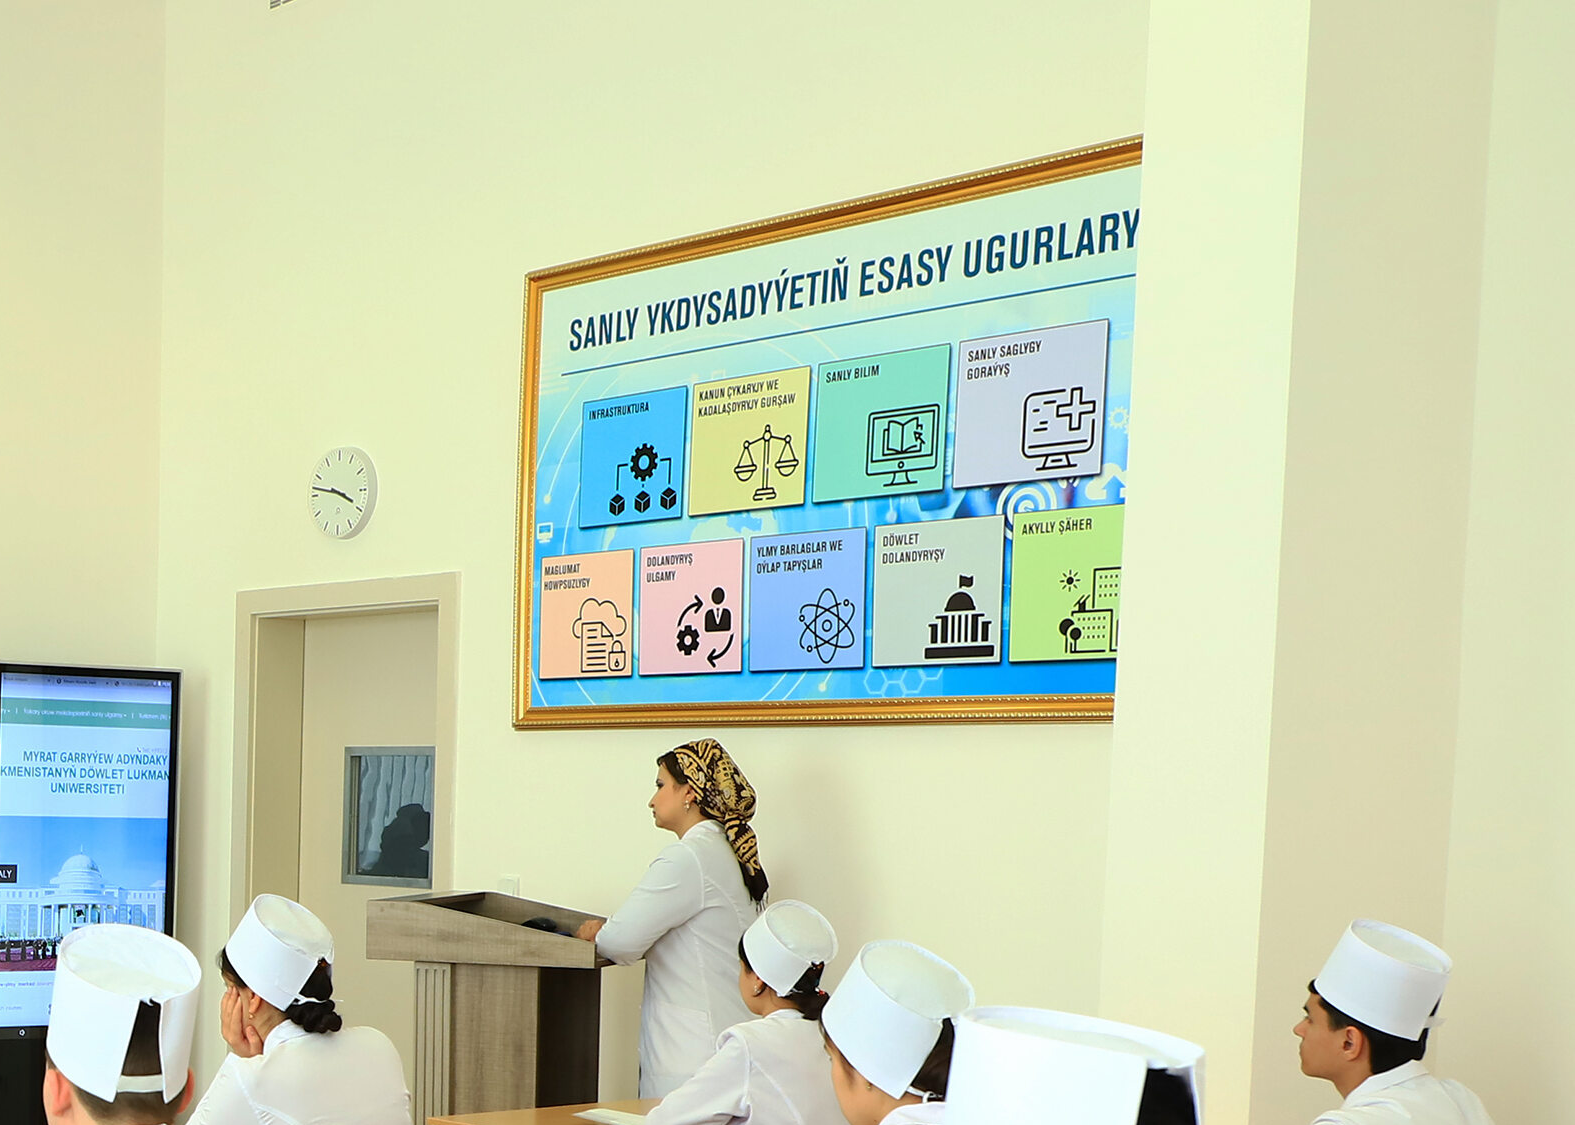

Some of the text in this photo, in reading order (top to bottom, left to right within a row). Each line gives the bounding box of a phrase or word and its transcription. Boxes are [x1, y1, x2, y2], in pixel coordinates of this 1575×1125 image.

[569, 208, 1140, 352] SANLY YKDYSADYÝETIŇ ESASY UGURLARY
[967, 340, 1042, 363] SANLY SAGLYGY
[825, 364, 880, 384] SANLY BILIM
[966, 361, 1011, 381] GORAÝYŞ
[699, 379, 779, 402] KANUN ÇYKARYJY WE
[760, 392, 796, 408] GURŞAW
[589, 401, 650, 421] INFRASTRUKTURA
[1022, 517, 1092, 535] AKYLLY ŞÄHER
[882, 533, 920, 547] DÖWLET
[756, 540, 843, 558] YLMY BARLAGLAR WE
[882, 549, 945, 564] DOLANDYRYŞY
[646, 553, 693, 567] DOLANDYRYŞ
[756, 558, 823, 574] OÝLAP TAPYŞLAR
[544, 563, 581, 576] MAGLUMAT
[646, 570, 676, 583] ULGAMY
[544, 578, 590, 591] HOWPSUZLYGY
[23, 750, 168, 766] MYRAT GARRYÝEW ADYNDAKY
[0, 764, 76, 778] KMENISTANYŇ
[79, 766, 125, 780] DÖWLET
[50, 782, 125, 794] UNIWERSITETI
